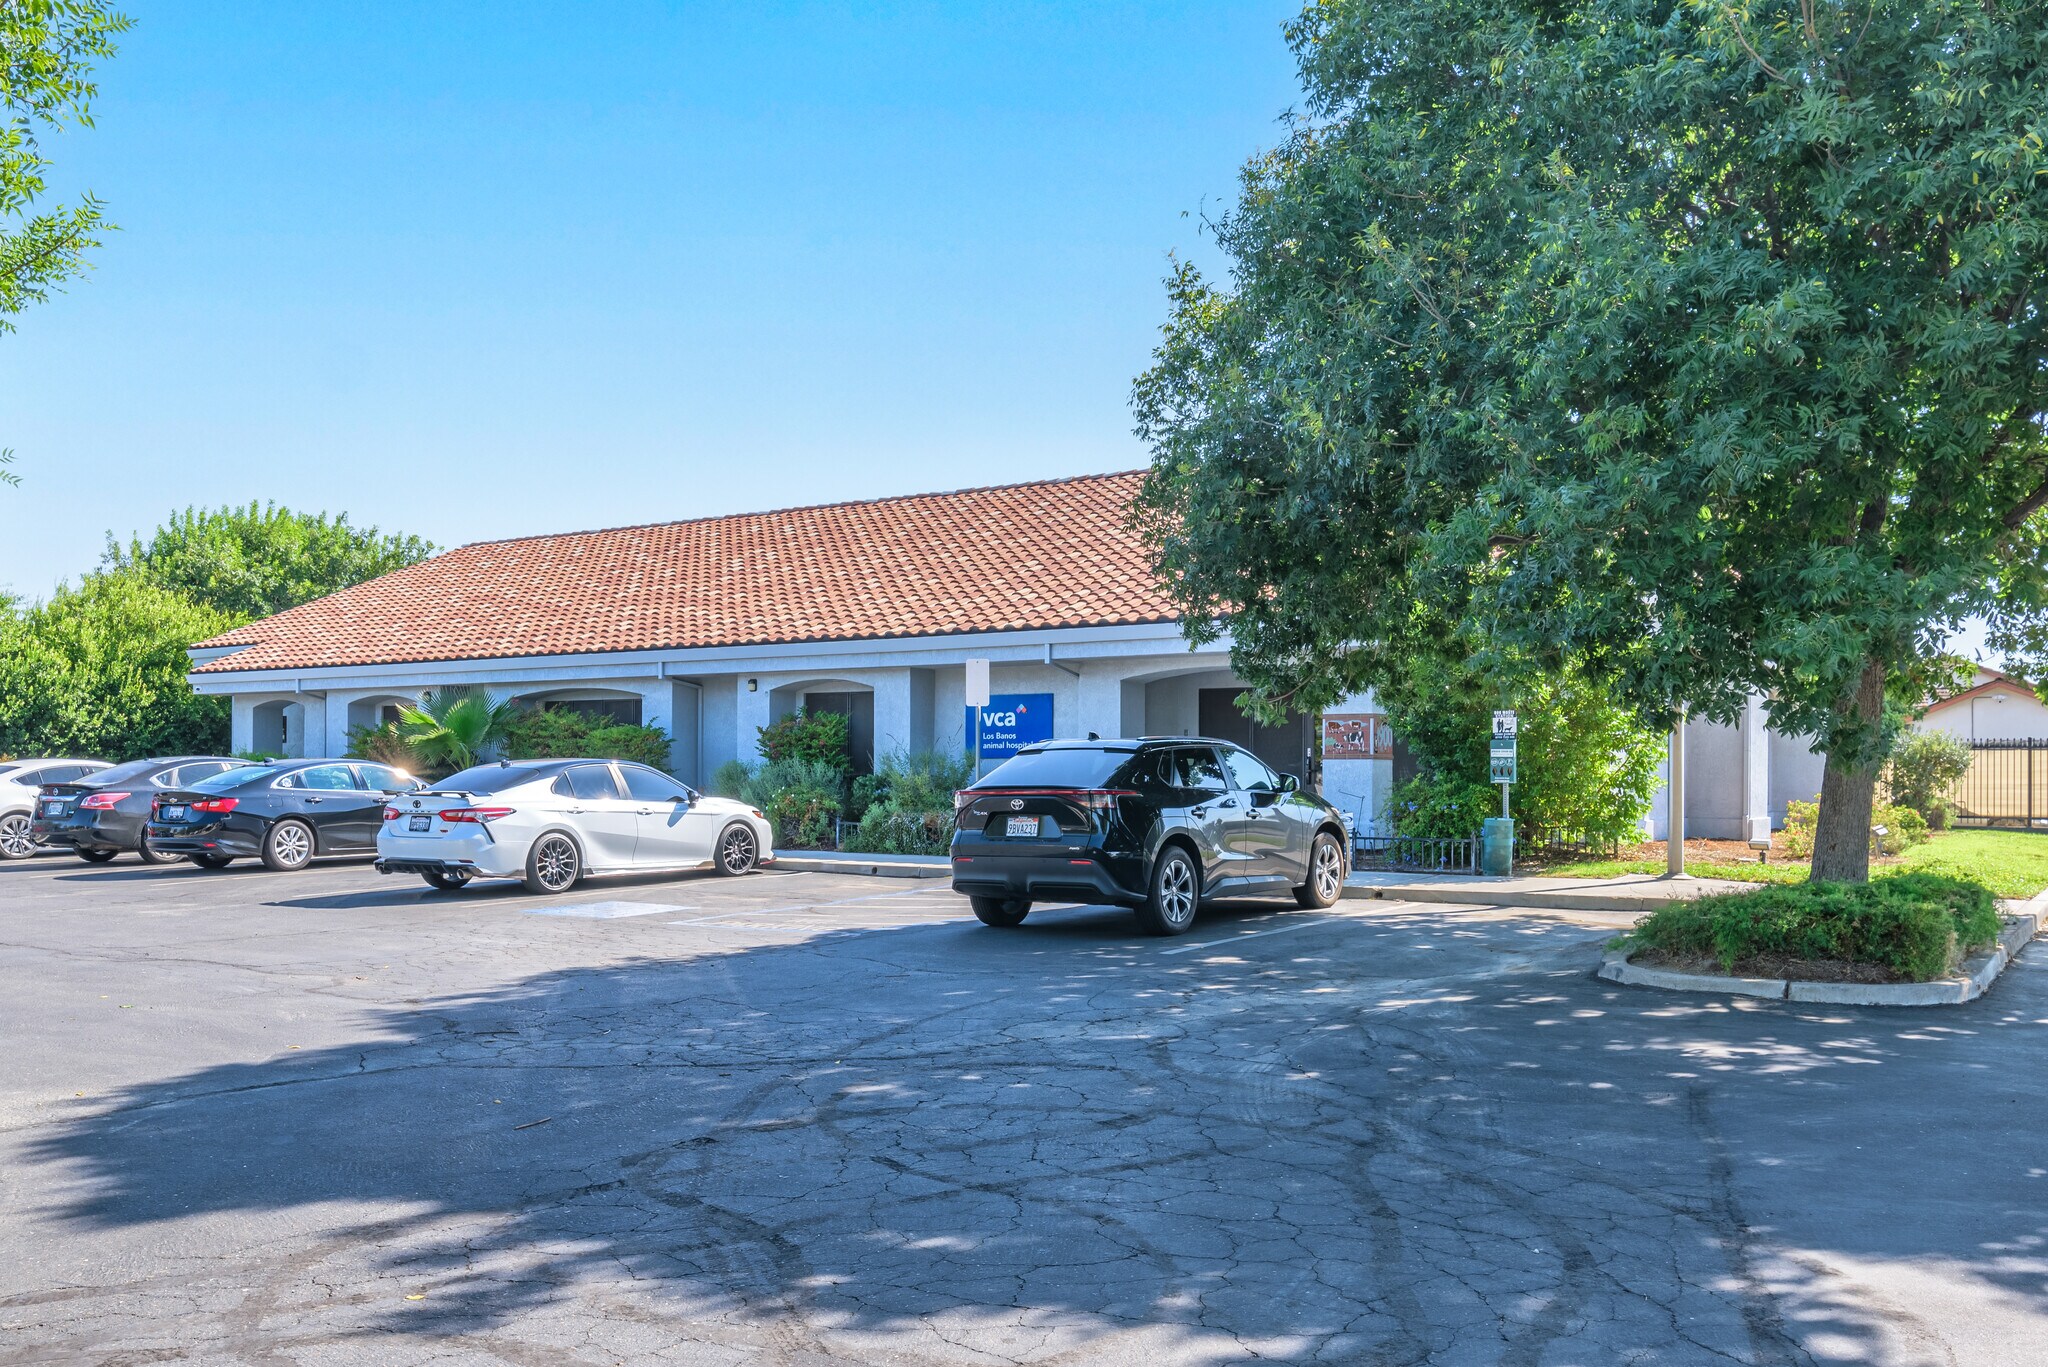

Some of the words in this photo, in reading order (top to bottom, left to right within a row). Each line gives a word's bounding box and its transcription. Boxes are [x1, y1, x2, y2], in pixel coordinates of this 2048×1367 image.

[982, 711, 1016, 727] vca
[982, 732, 995, 740] Los
[996, 732, 1017, 740] Banos
[982, 741, 1005, 750] animal
[1006, 741, 1034, 751] hospit
[1007, 823, 1037, 835] 9BVA237
